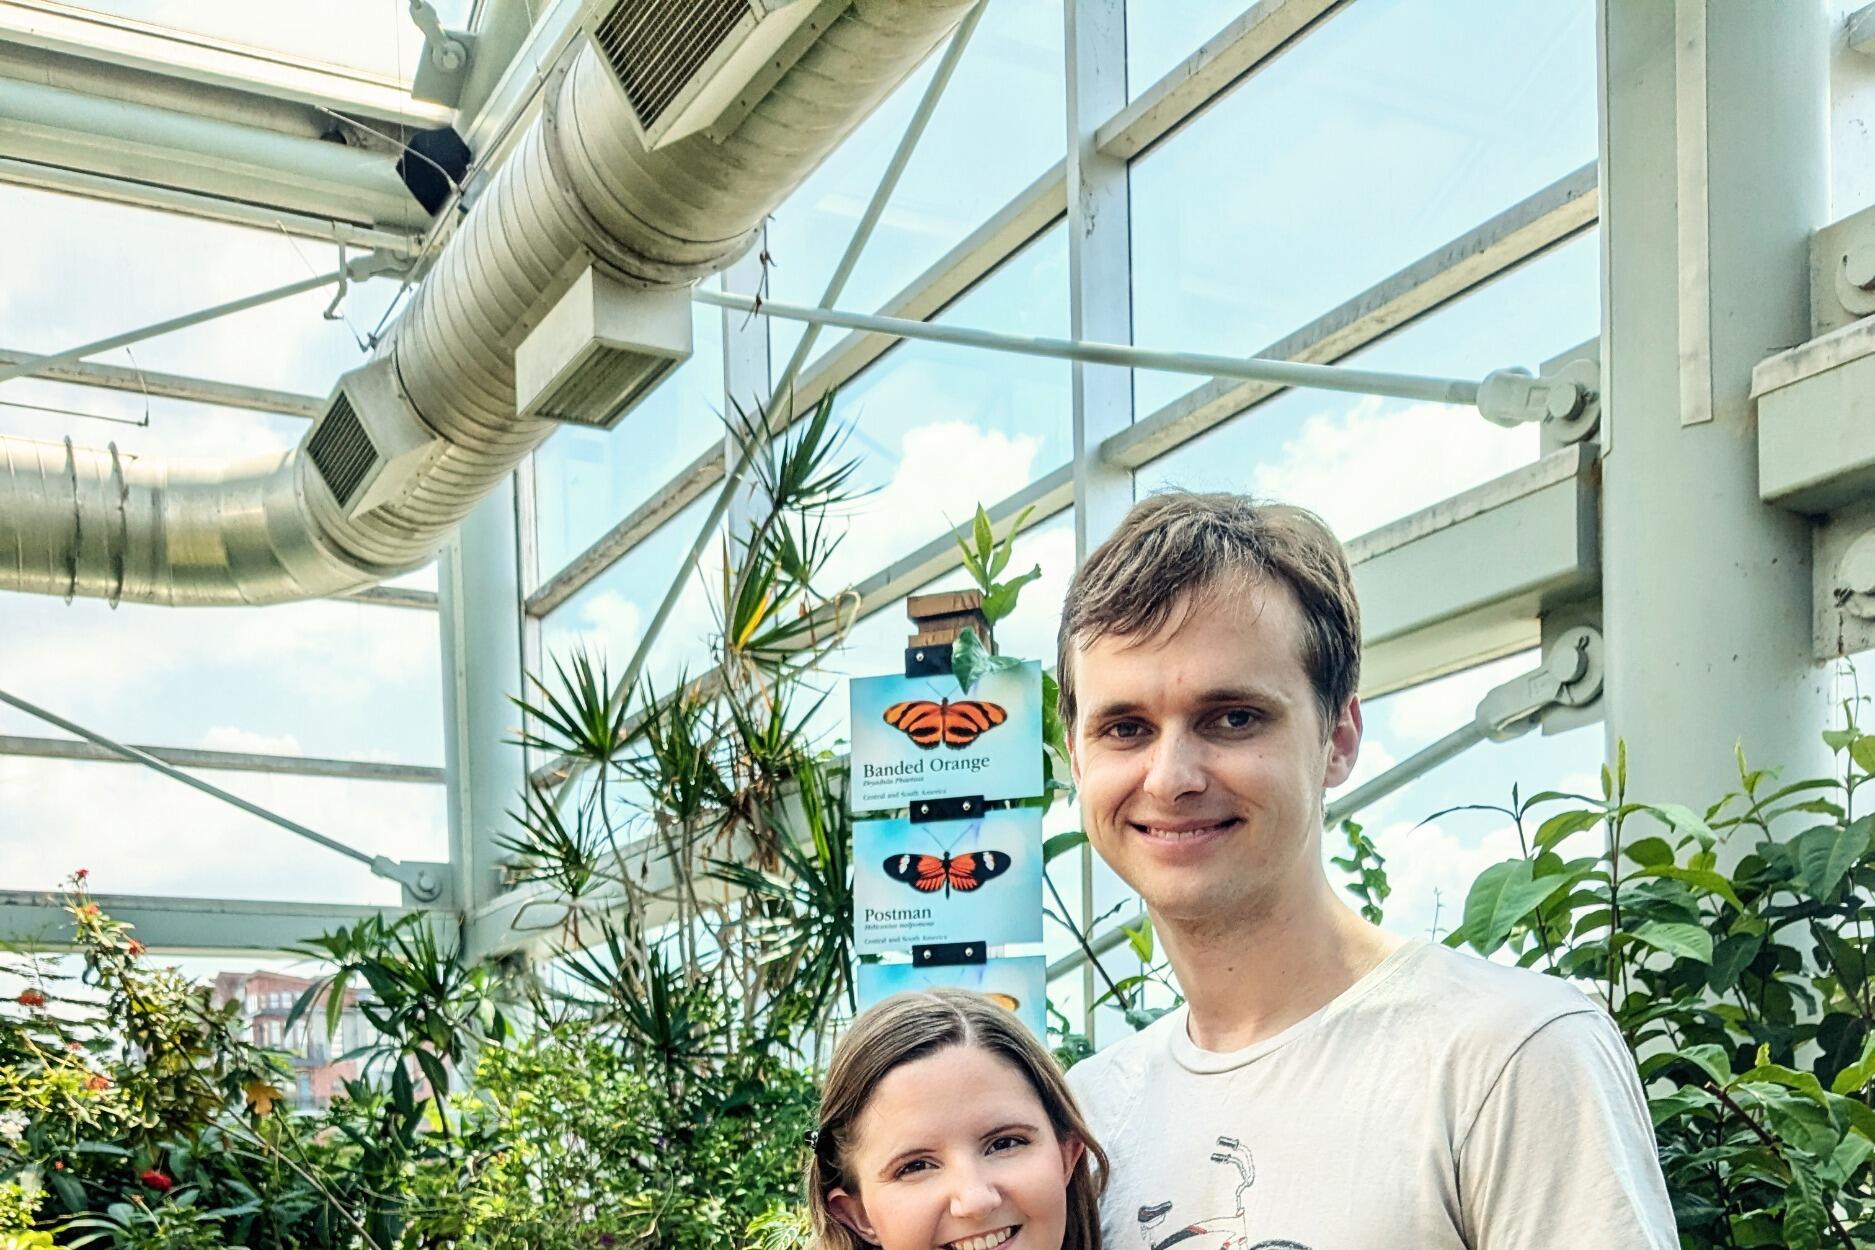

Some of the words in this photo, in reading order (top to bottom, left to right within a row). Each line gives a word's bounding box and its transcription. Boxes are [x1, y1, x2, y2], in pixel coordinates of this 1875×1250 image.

[863, 758, 924, 778] Banded
[930, 757, 990, 773] Orange
[865, 908, 932, 922] Postman
